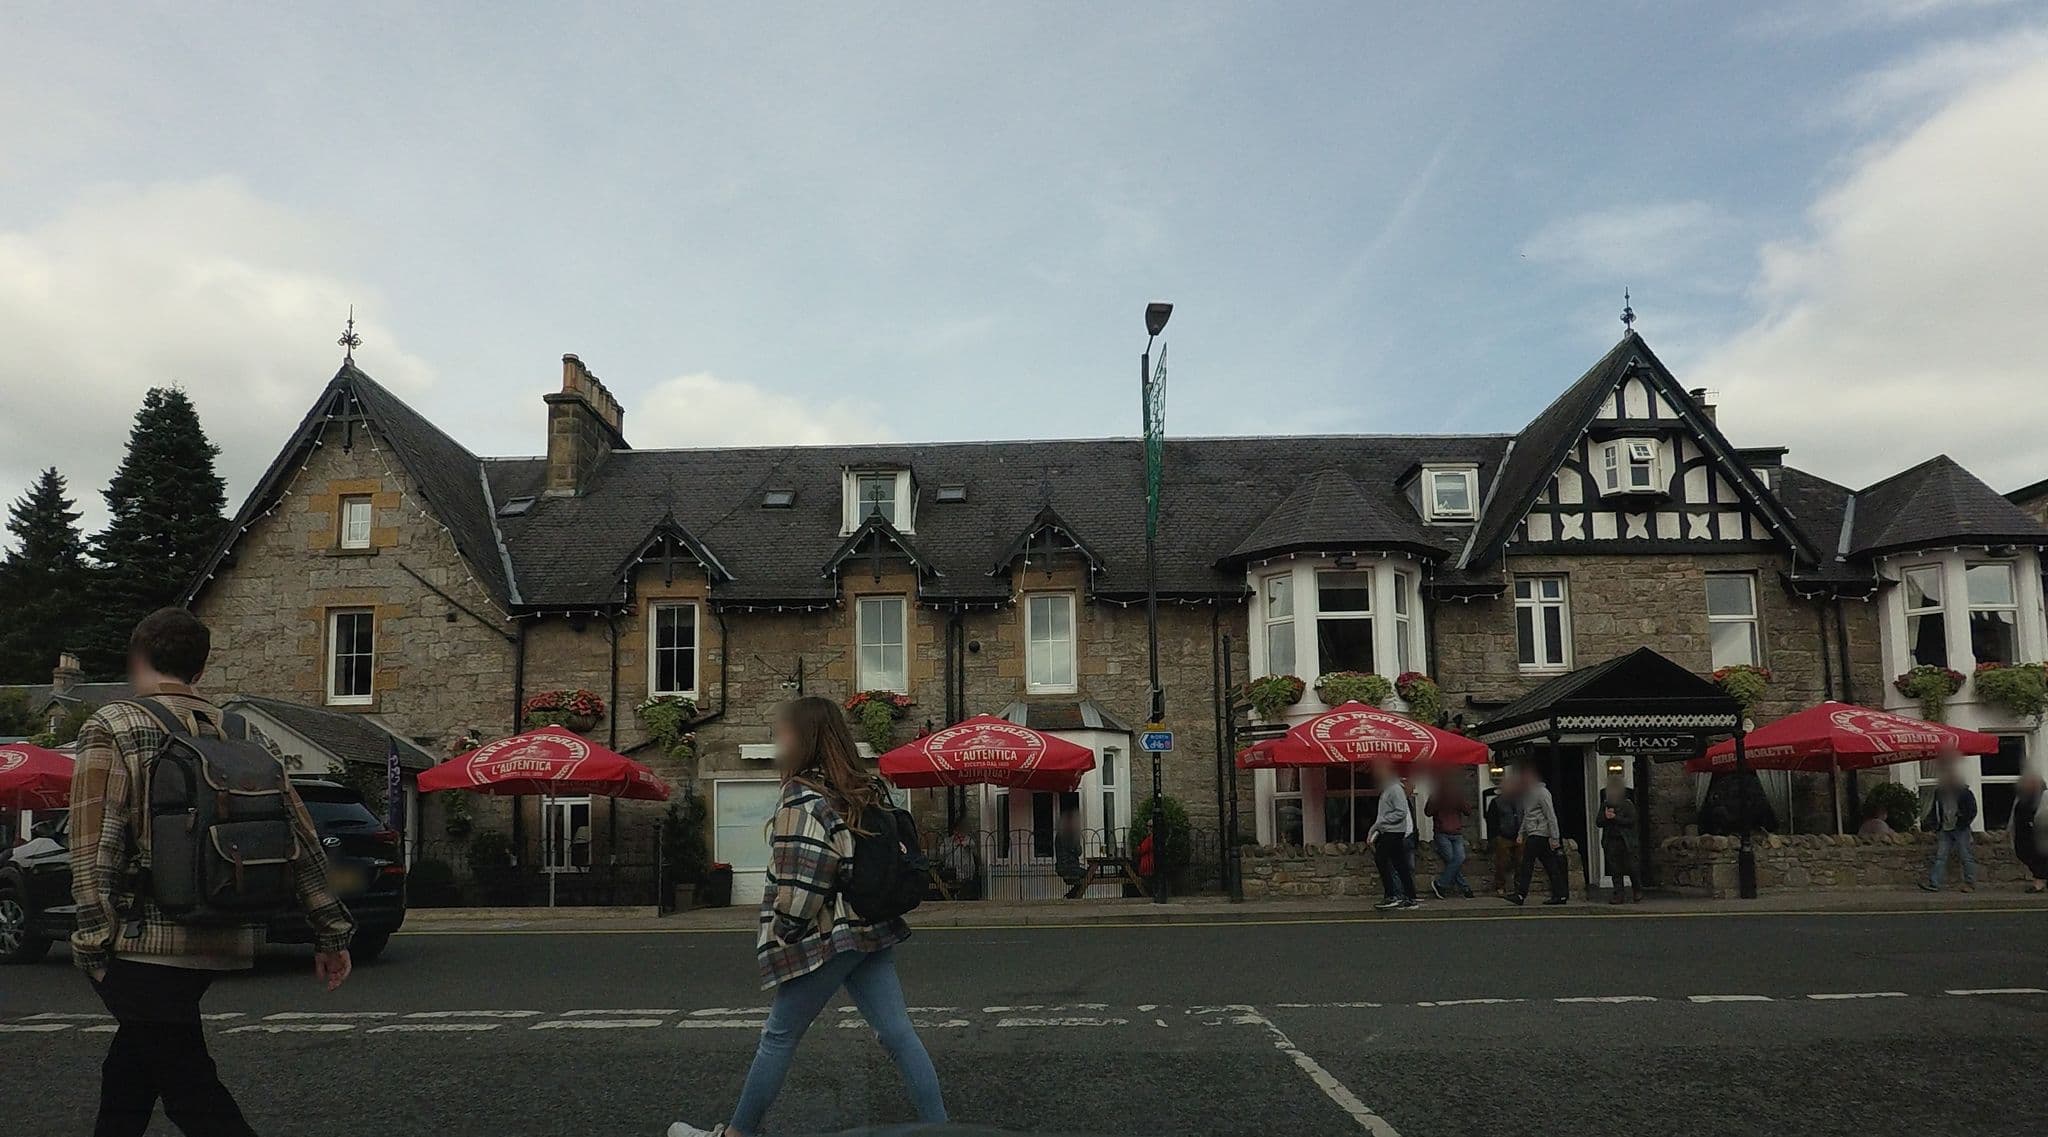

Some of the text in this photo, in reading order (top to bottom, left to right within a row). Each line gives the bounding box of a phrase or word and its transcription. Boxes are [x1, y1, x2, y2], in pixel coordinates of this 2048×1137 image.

[1315, 713, 1430, 739] BIRRA MORETTI
[930, 724, 1041, 750] BIRRA MORETTI
[1616, 737, 1679, 748] McKAYS
[1346, 741, 1411, 753] L'AUTENTICA
[954, 749, 1018, 762] L'AUTENTICA
[491, 759, 551, 775] L'AUTENTICA
